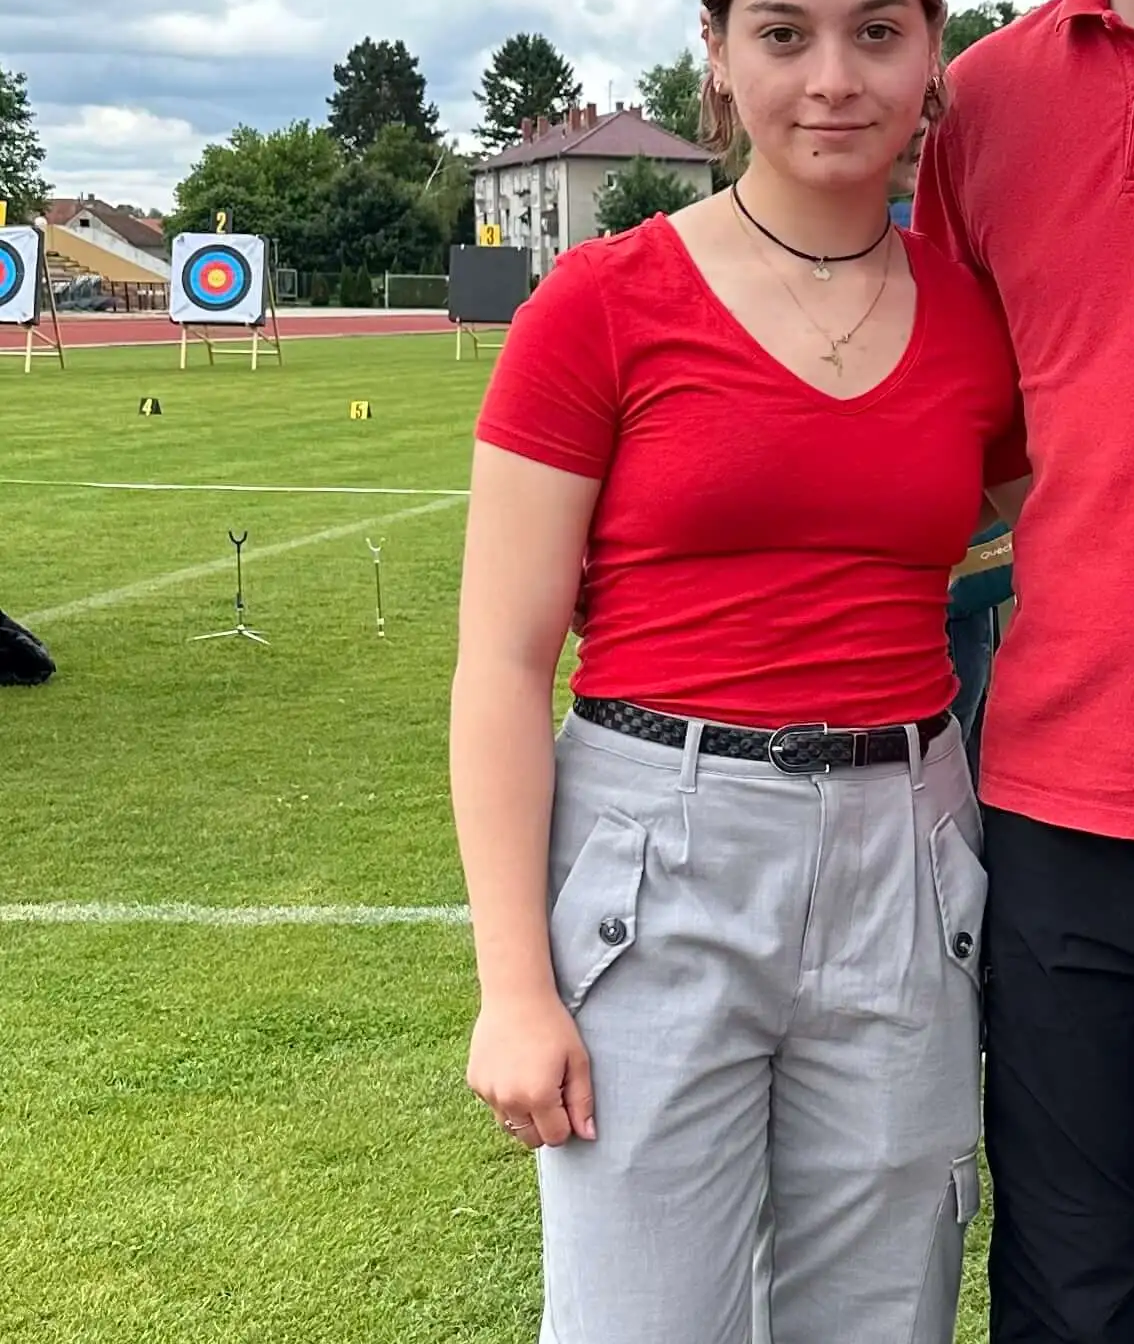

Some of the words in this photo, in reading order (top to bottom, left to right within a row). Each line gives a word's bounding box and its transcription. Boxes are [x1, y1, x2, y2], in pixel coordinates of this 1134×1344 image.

[216, 211, 227, 233] 2
[486, 226, 495, 245] 3
[142, 398, 153, 416] 4
[355, 403, 363, 419] 5
